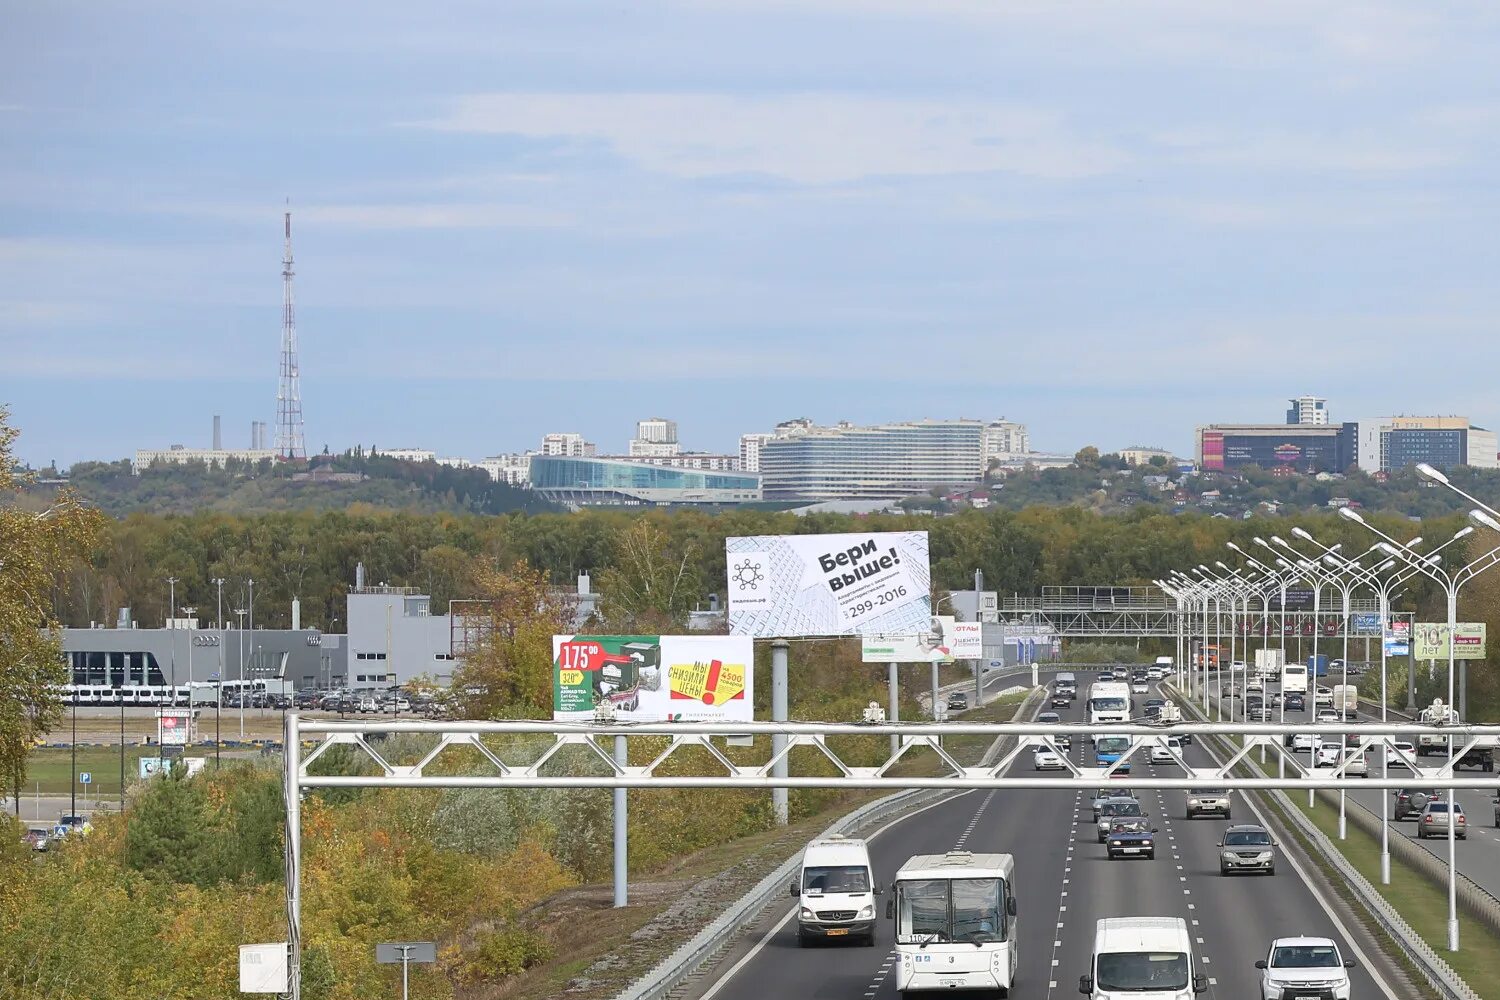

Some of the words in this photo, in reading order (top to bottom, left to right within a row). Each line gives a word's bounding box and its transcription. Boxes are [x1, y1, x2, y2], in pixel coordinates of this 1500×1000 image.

[818, 539, 878, 573] Бери
[828, 547, 900, 592] выше!
[849, 585, 907, 618] 299-2016
[563, 645, 588, 669] 175
[1422, 646, 1439, 655] лет
[668, 666, 704, 686] СНИЗИЛИ
[693, 661, 707, 674] МЫ
[721, 672, 742, 683] 4500
[679, 682, 702, 696] ЦЕНЫ
